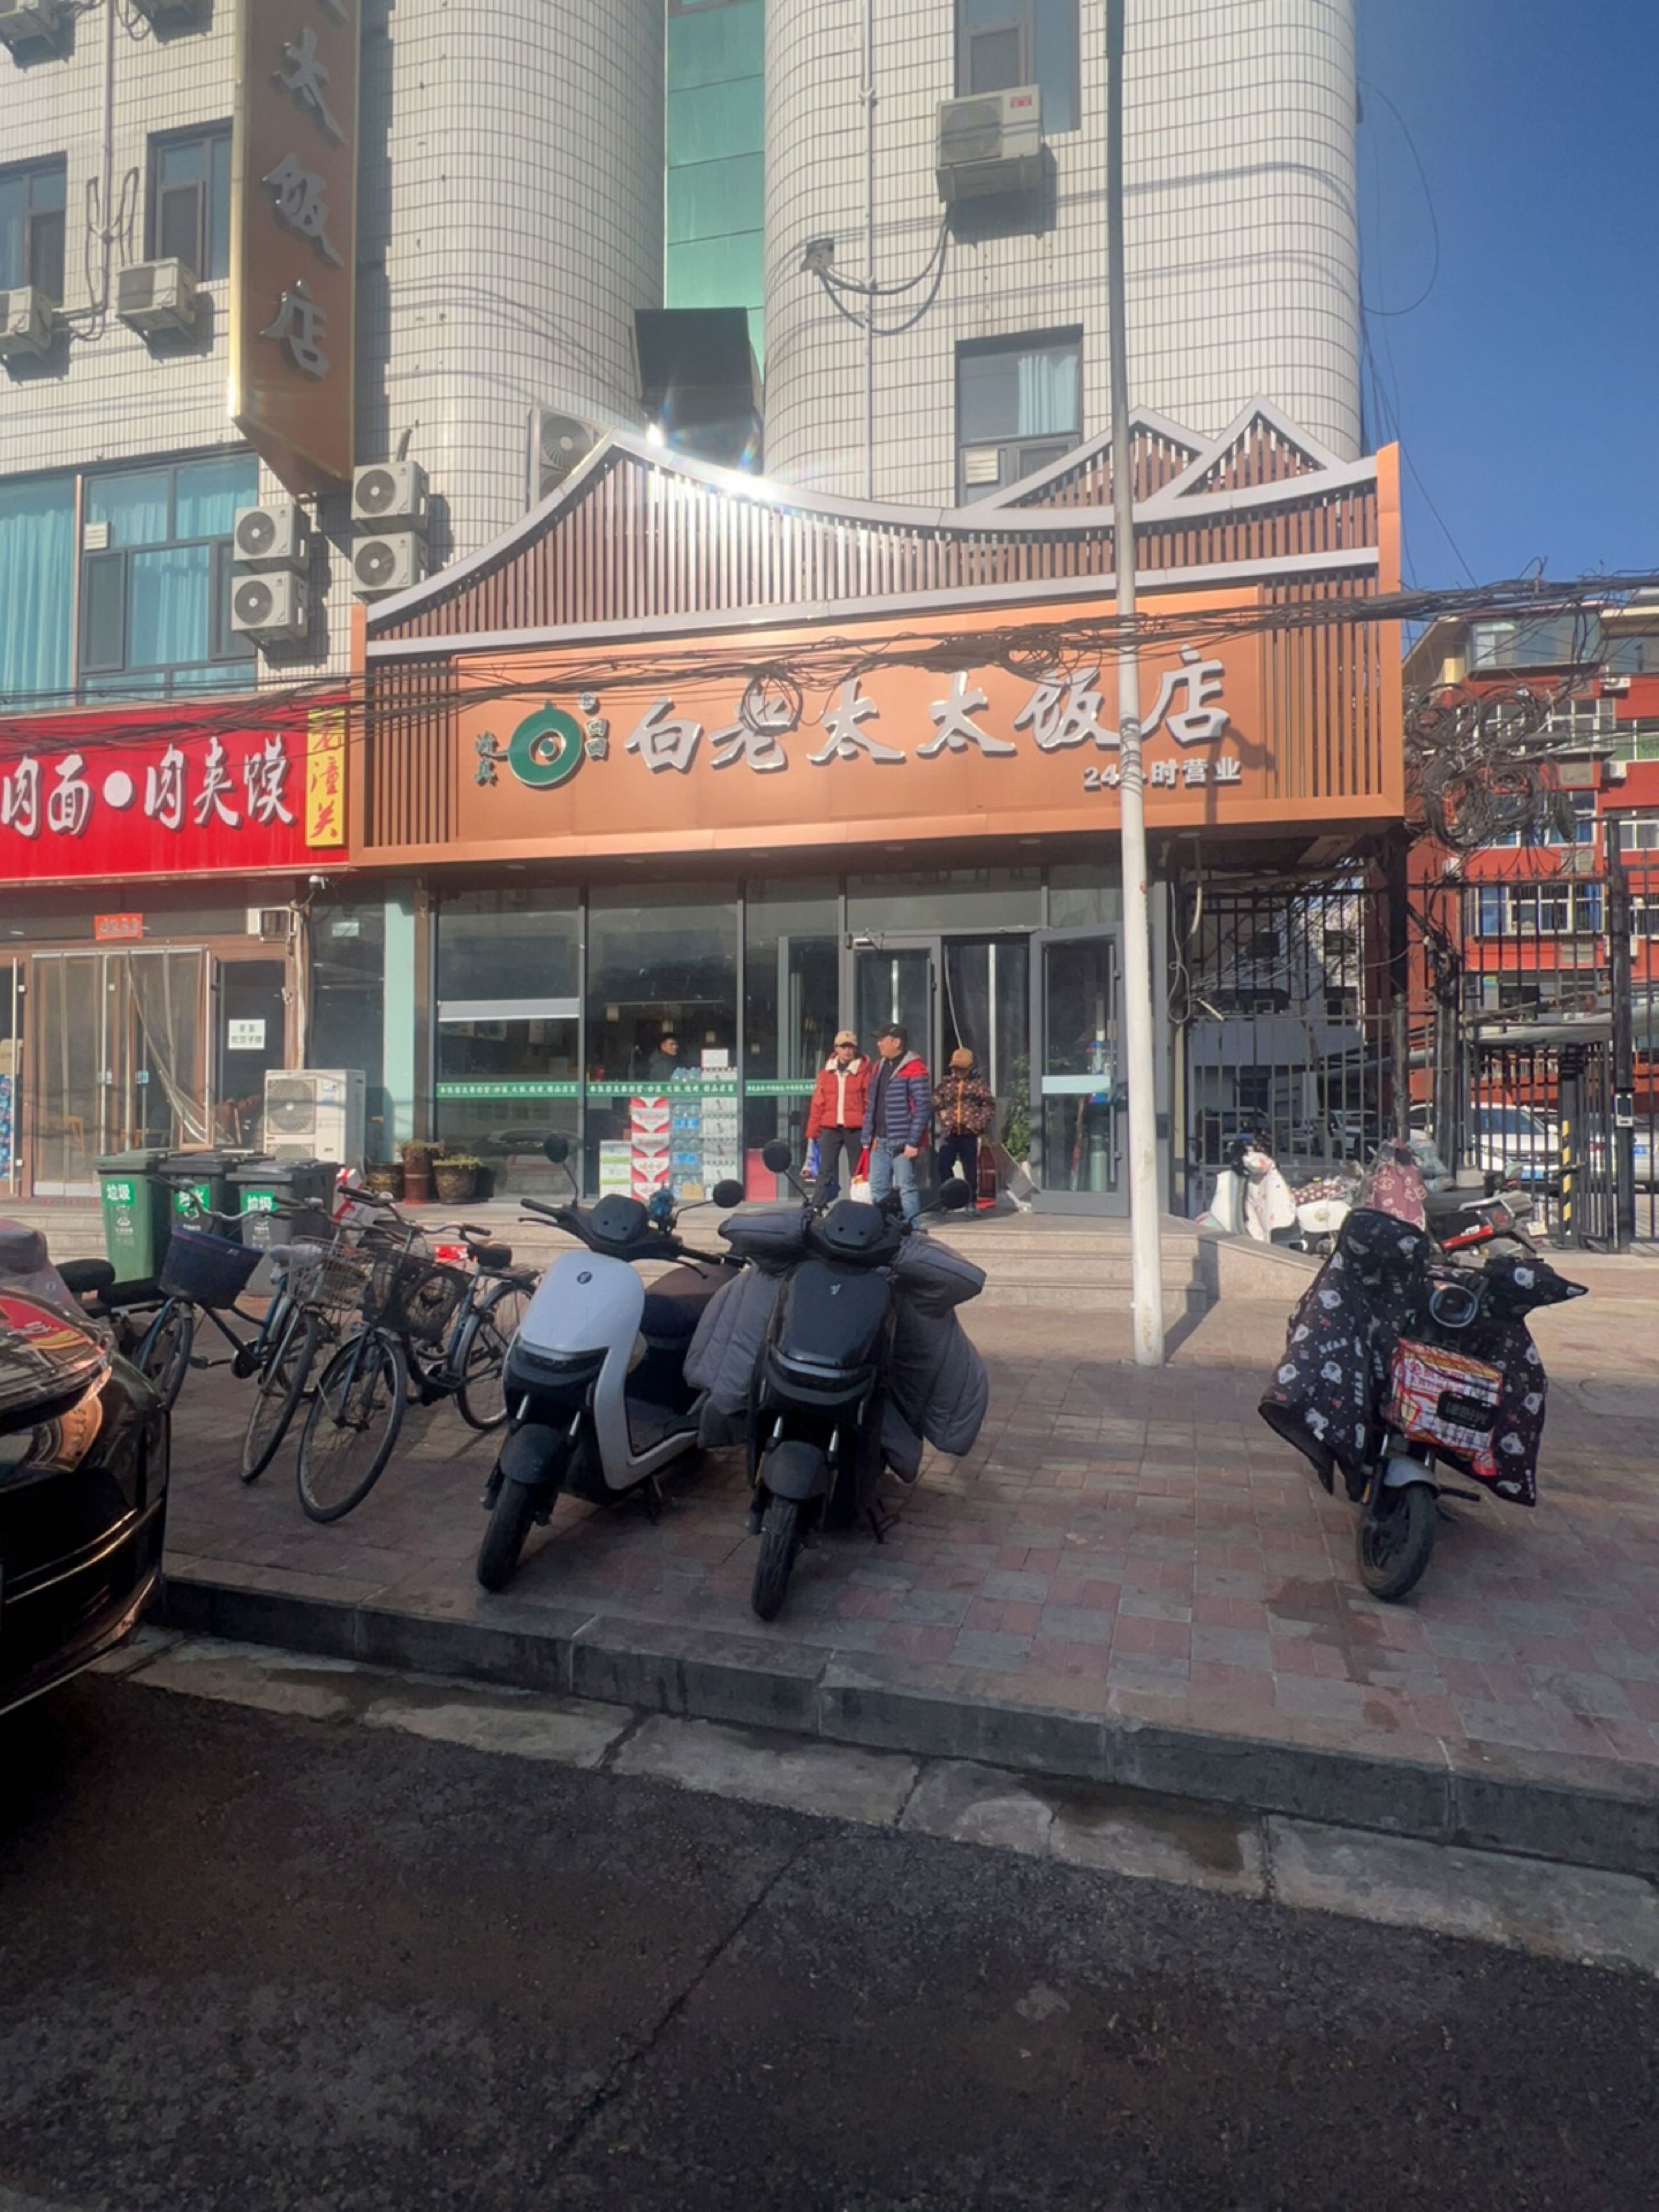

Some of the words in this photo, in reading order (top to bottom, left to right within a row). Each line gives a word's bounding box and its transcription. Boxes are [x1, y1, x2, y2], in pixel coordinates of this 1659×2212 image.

[259, 0, 349, 379] 太饭店
[625, 643, 1230, 770] 白老太太饭店
[144, 733, 293, 830] 肉夹馍
[1084, 757, 1241, 789] 24时营业
